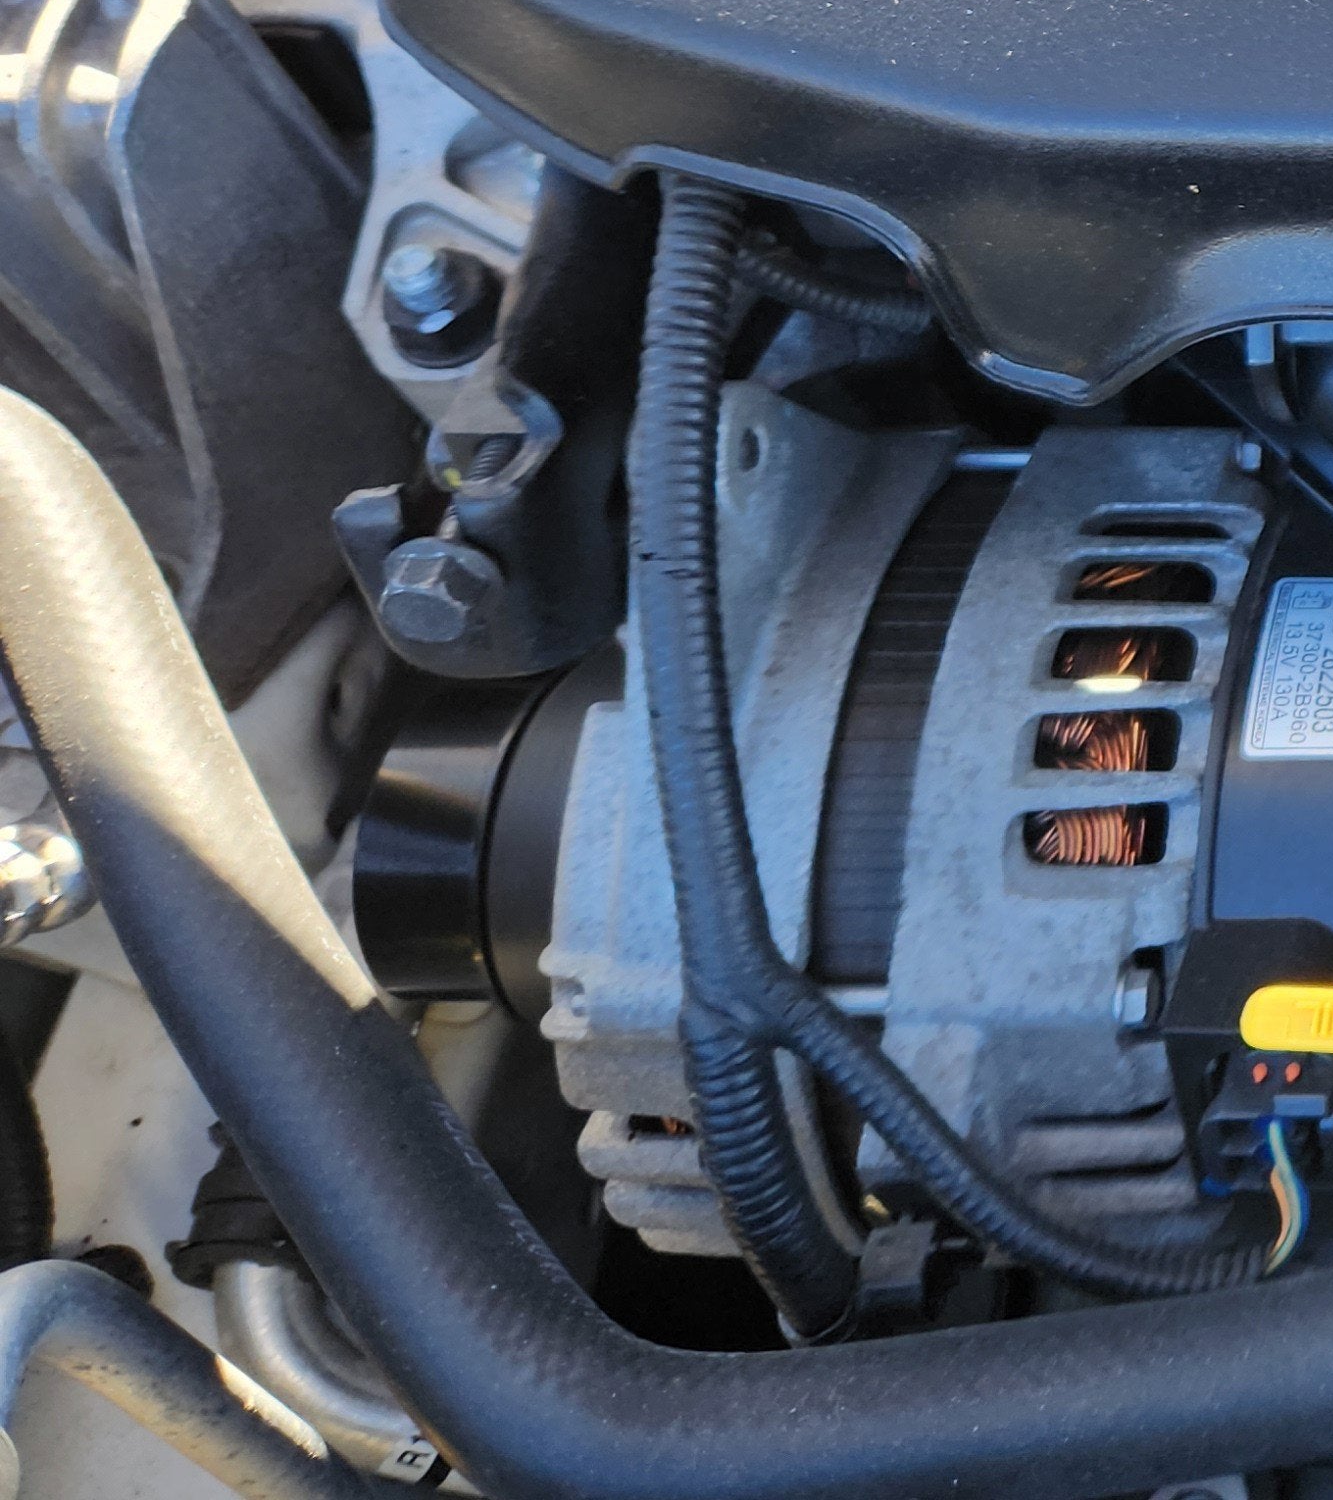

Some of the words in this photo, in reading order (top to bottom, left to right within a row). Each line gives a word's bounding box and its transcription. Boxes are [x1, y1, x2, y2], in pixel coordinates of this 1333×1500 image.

[1280, 623, 1303, 668] 13.5V
[1270, 675, 1293, 721] 130A
[1289, 622, 1325, 744] 37300-2B960
